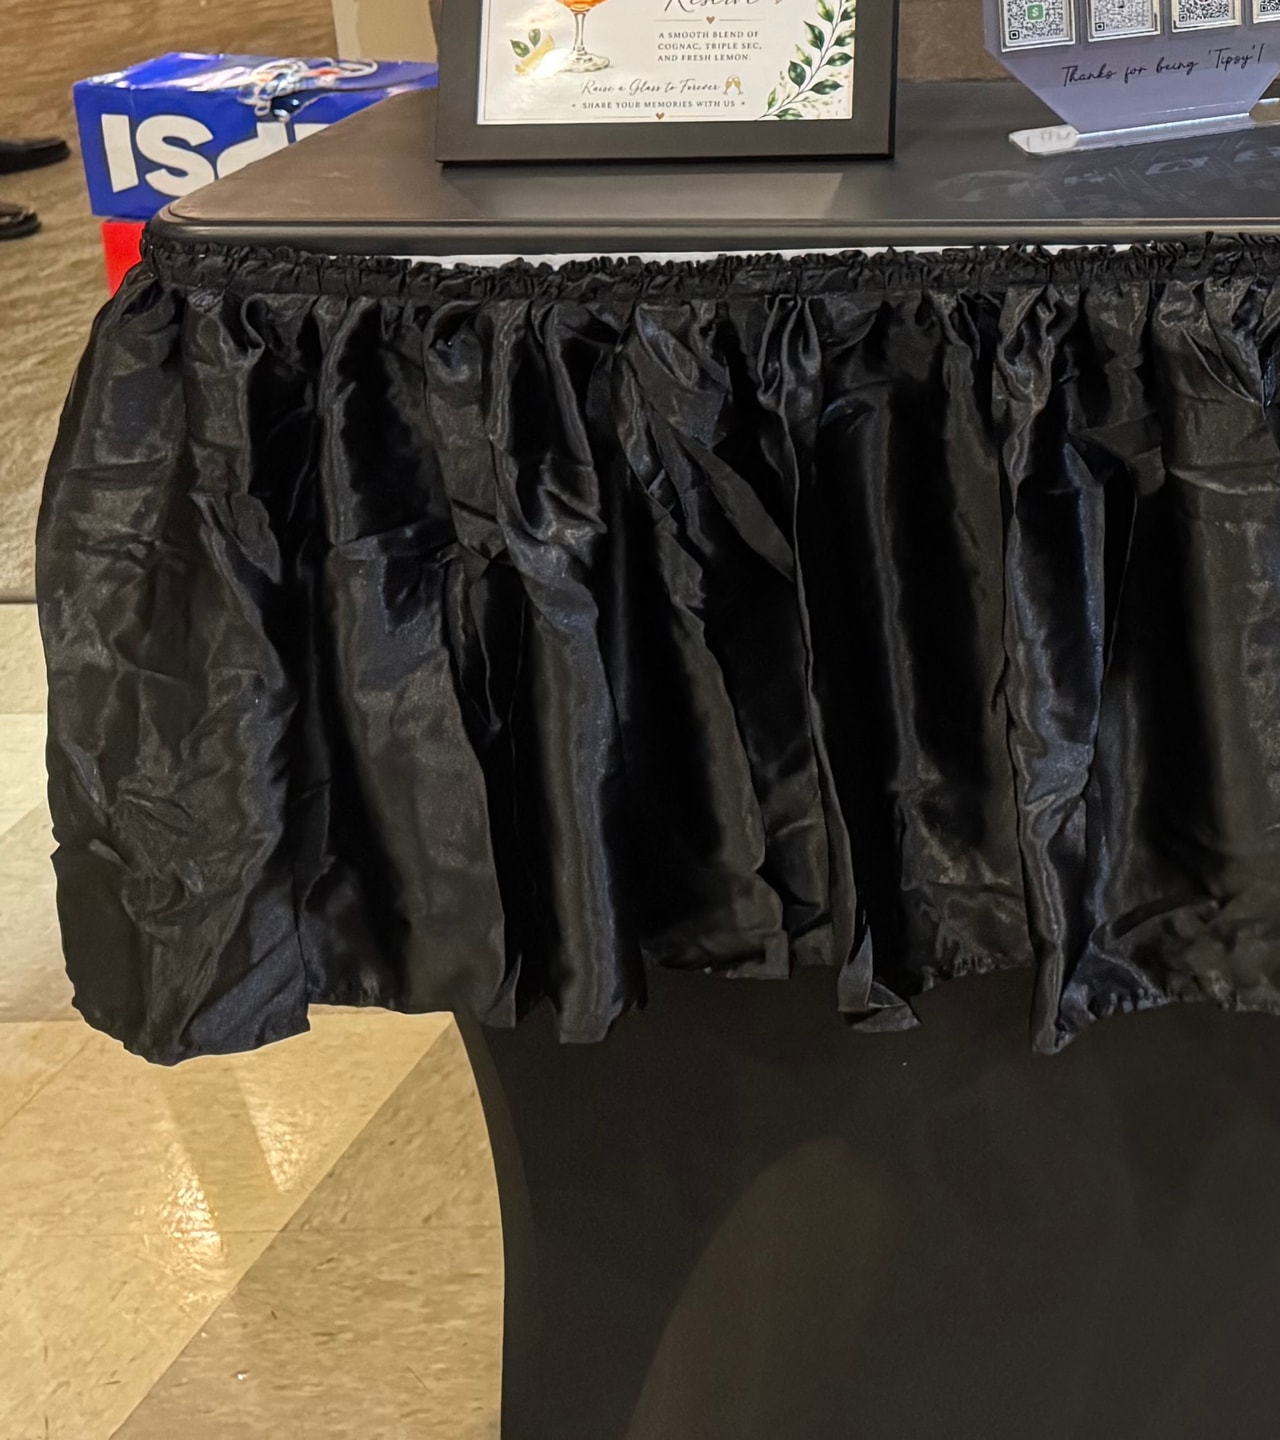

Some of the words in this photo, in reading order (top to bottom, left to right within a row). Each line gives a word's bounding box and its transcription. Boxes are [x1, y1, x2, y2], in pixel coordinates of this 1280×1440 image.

[668, 31, 709, 39] SMOOTH
[747, 30, 759, 38] OF
[1062, 63, 1116, 87] Thanks
[1124, 67, 1147, 84] for
[1156, 57, 1198, 75] being
[629, 78, 662, 96] Glass
[680, 78, 721, 94] Forever
[696, 100, 720, 108] WITH
